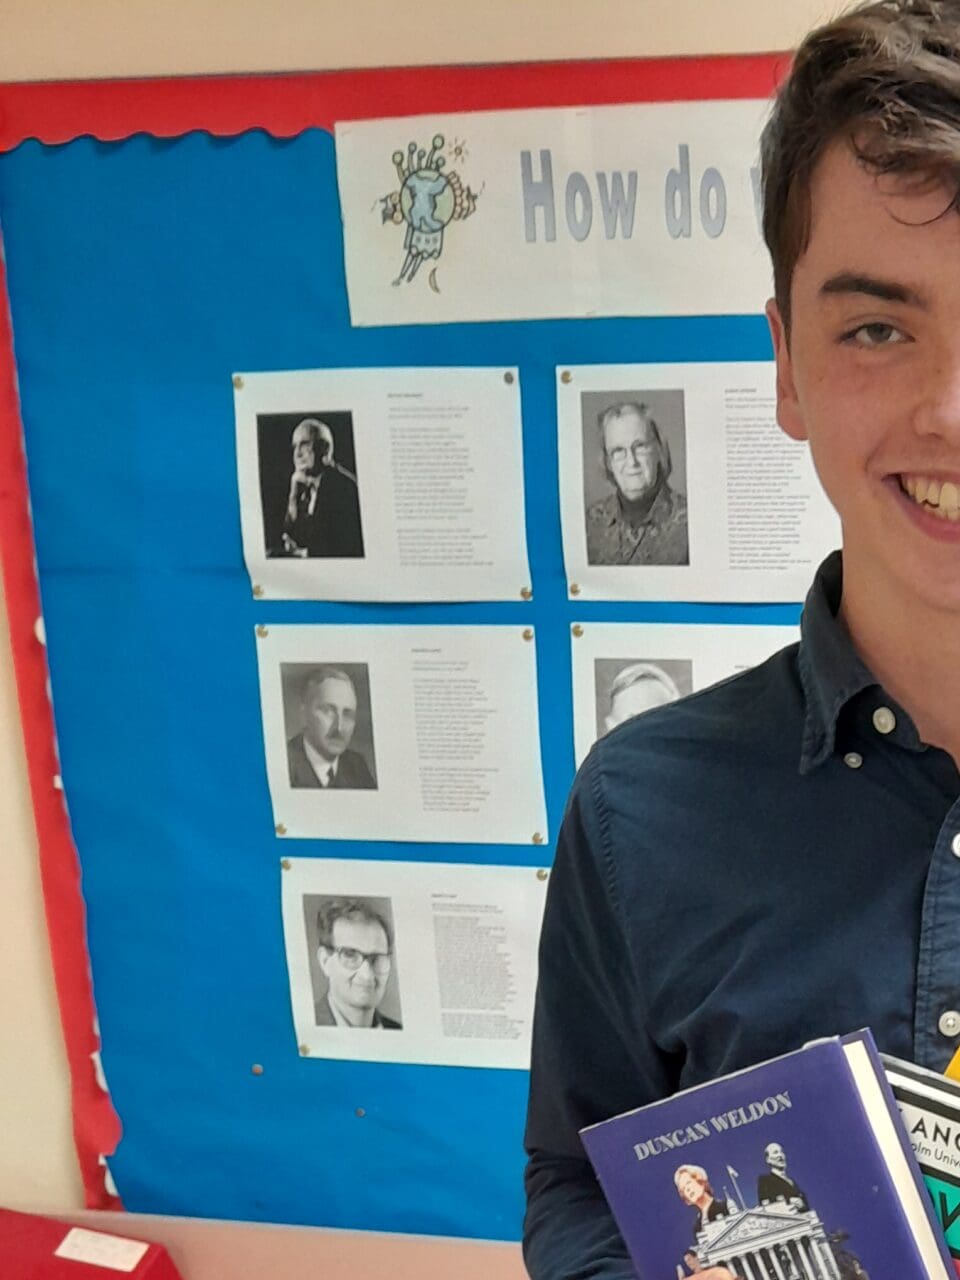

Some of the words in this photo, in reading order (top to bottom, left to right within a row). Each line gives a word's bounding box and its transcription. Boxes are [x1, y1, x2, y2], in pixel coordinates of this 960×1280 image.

[520, 148, 639, 243] How
[663, 144, 728, 241] do
[633, 1120, 711, 1160] DUNCAN
[709, 1091, 793, 1133] WELDON
[911, 1141, 932, 1157] olm
